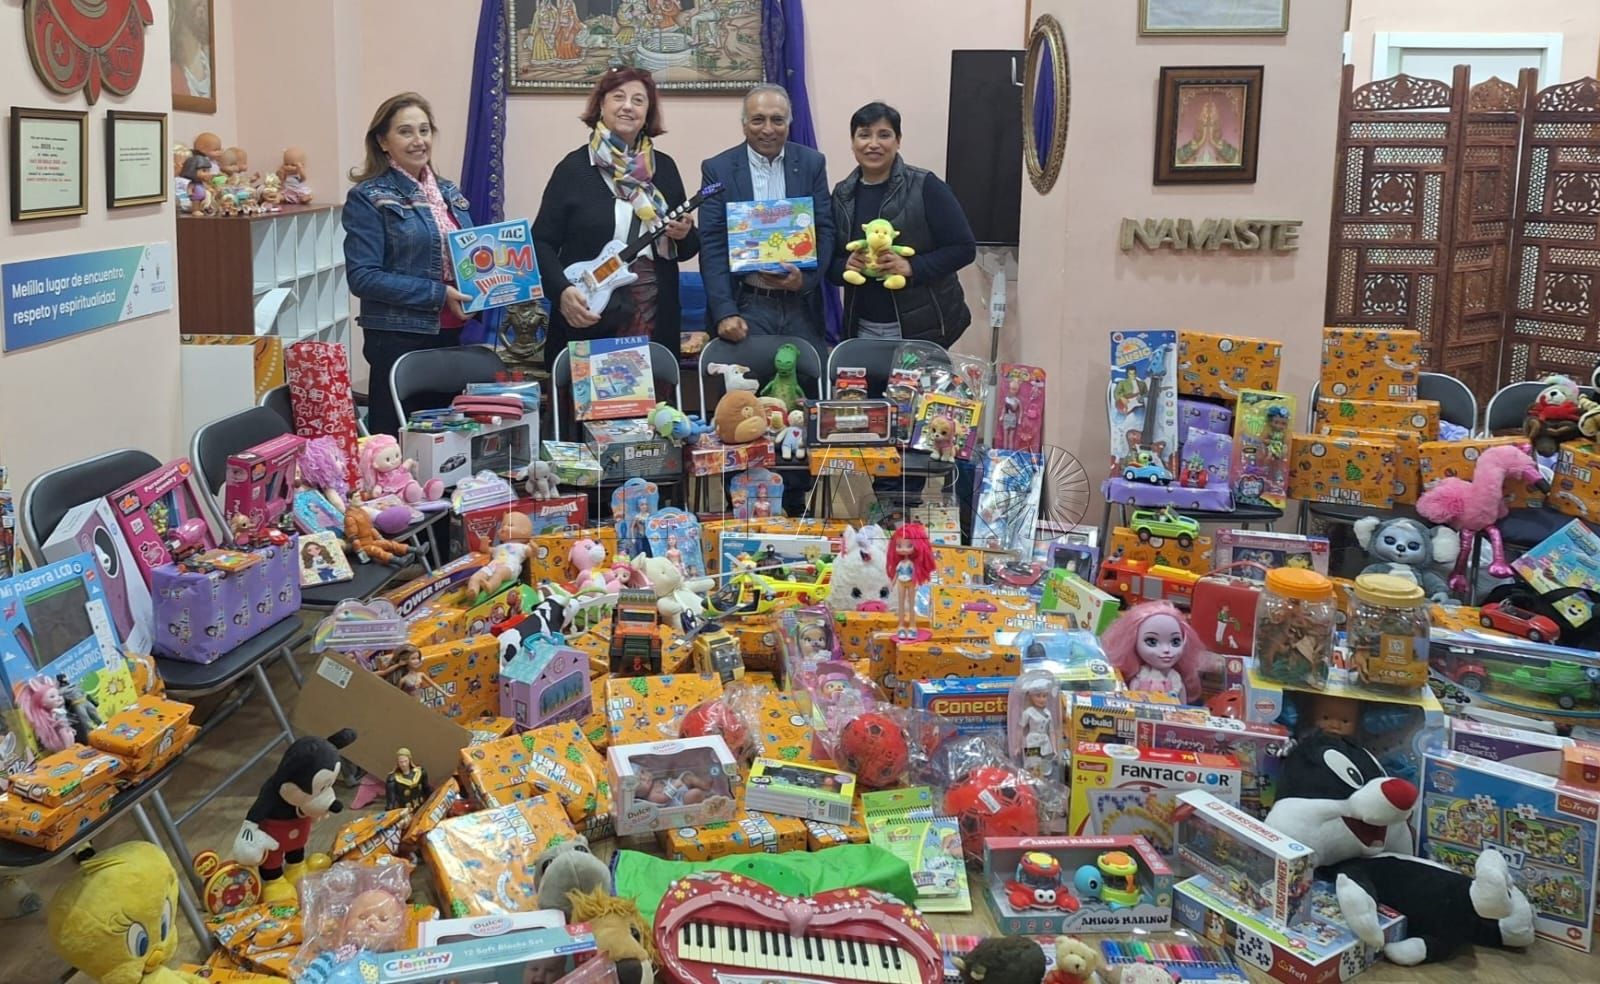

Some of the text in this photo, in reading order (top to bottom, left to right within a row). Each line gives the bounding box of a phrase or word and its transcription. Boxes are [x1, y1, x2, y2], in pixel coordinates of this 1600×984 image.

[1120, 217, 1303, 252] NAMASTE
[458, 244, 534, 280] BOUM
[12, 279, 45, 299] Melilla
[46, 274, 70, 292] lugar
[71, 271, 83, 287] de
[13, 288, 116, 326] respeto y espiritualidad
[614, 337, 643, 346] PIXAR
[15, 569, 54, 597] pizarra
[54, 562, 73, 579] LCD
[1223, 807, 1283, 842] TRANSFORMERS
[1275, 859, 1289, 921] TRANSFORMERS
[1081, 915, 1120, 927] AMIGOS
[1122, 914, 1169, 925] MARINOS
[386, 952, 451, 972] Clemmy
